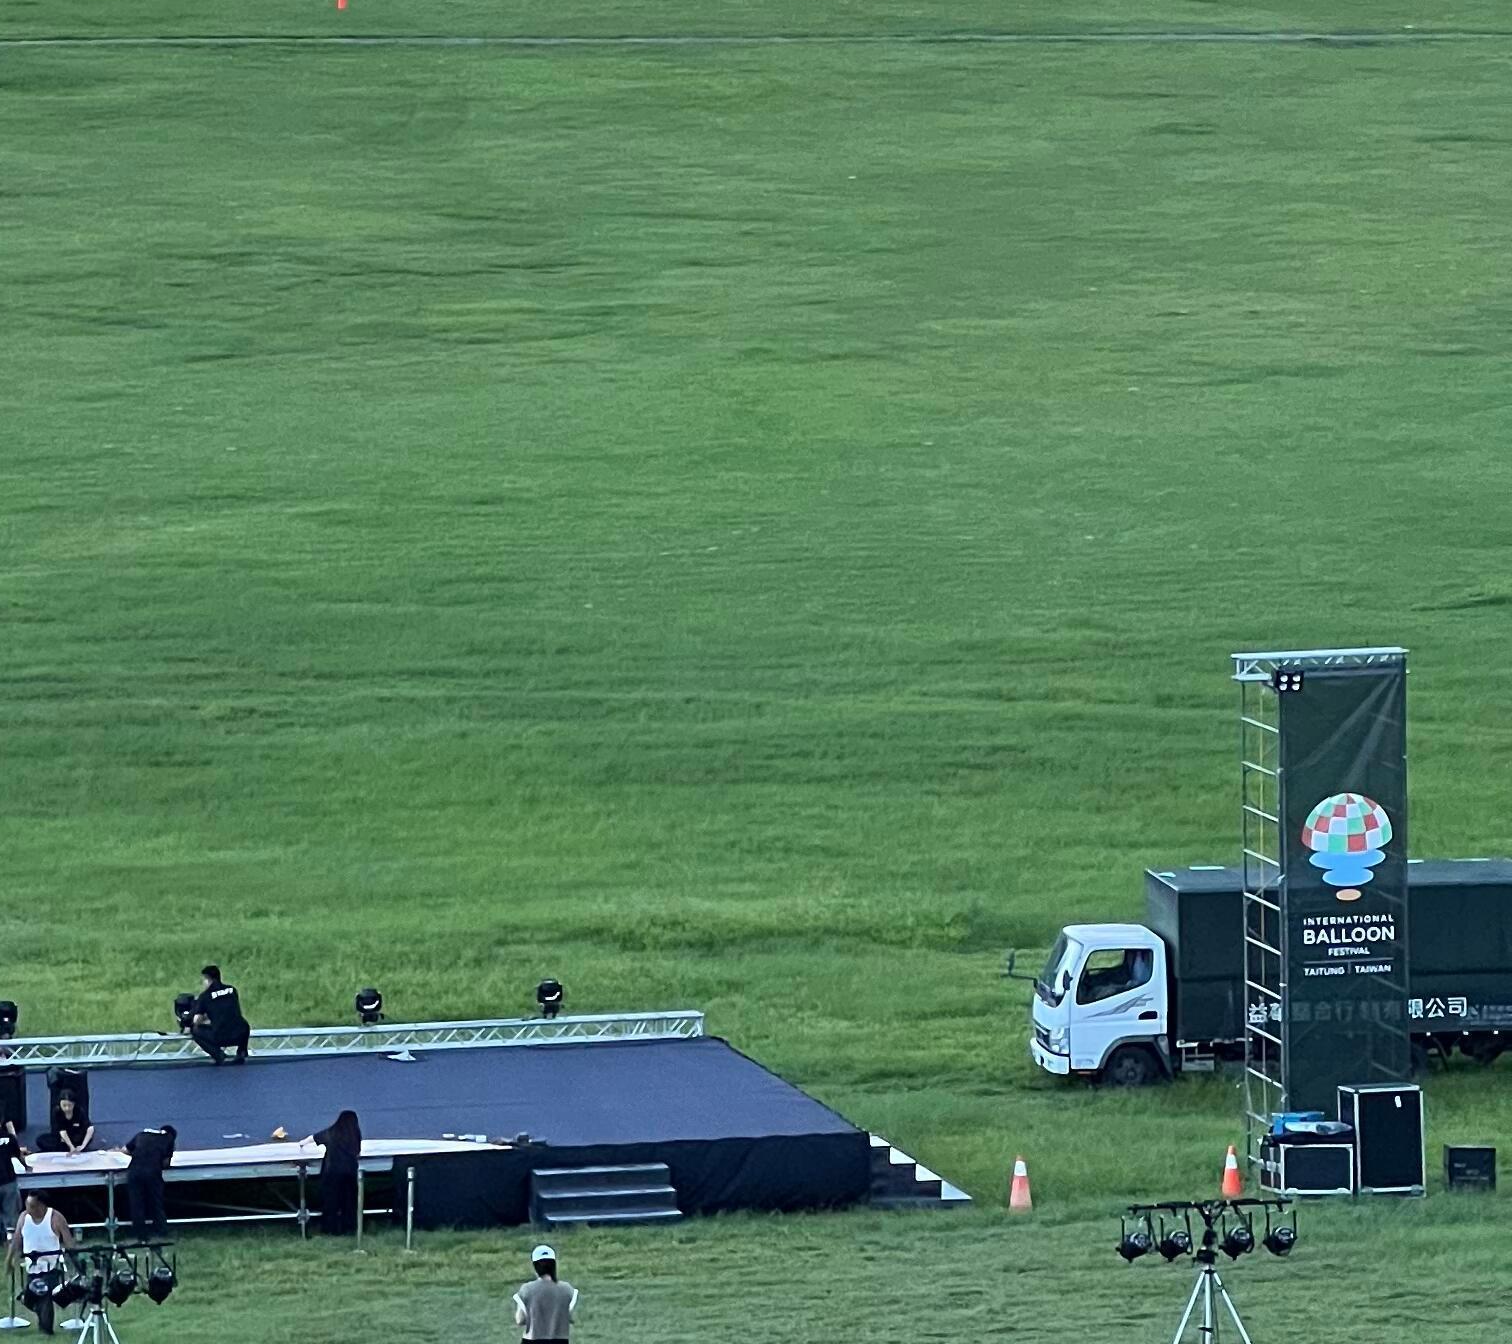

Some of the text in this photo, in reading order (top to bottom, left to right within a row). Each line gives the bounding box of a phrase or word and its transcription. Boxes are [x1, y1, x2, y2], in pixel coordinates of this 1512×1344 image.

[1303, 914, 1395, 926] INTERNATIONAL
[1303, 926, 1395, 944] BALLOON
[1328, 947, 1370, 956] FESTIVAL
[1304, 965, 1392, 976] TAITUNG TAIWAN
